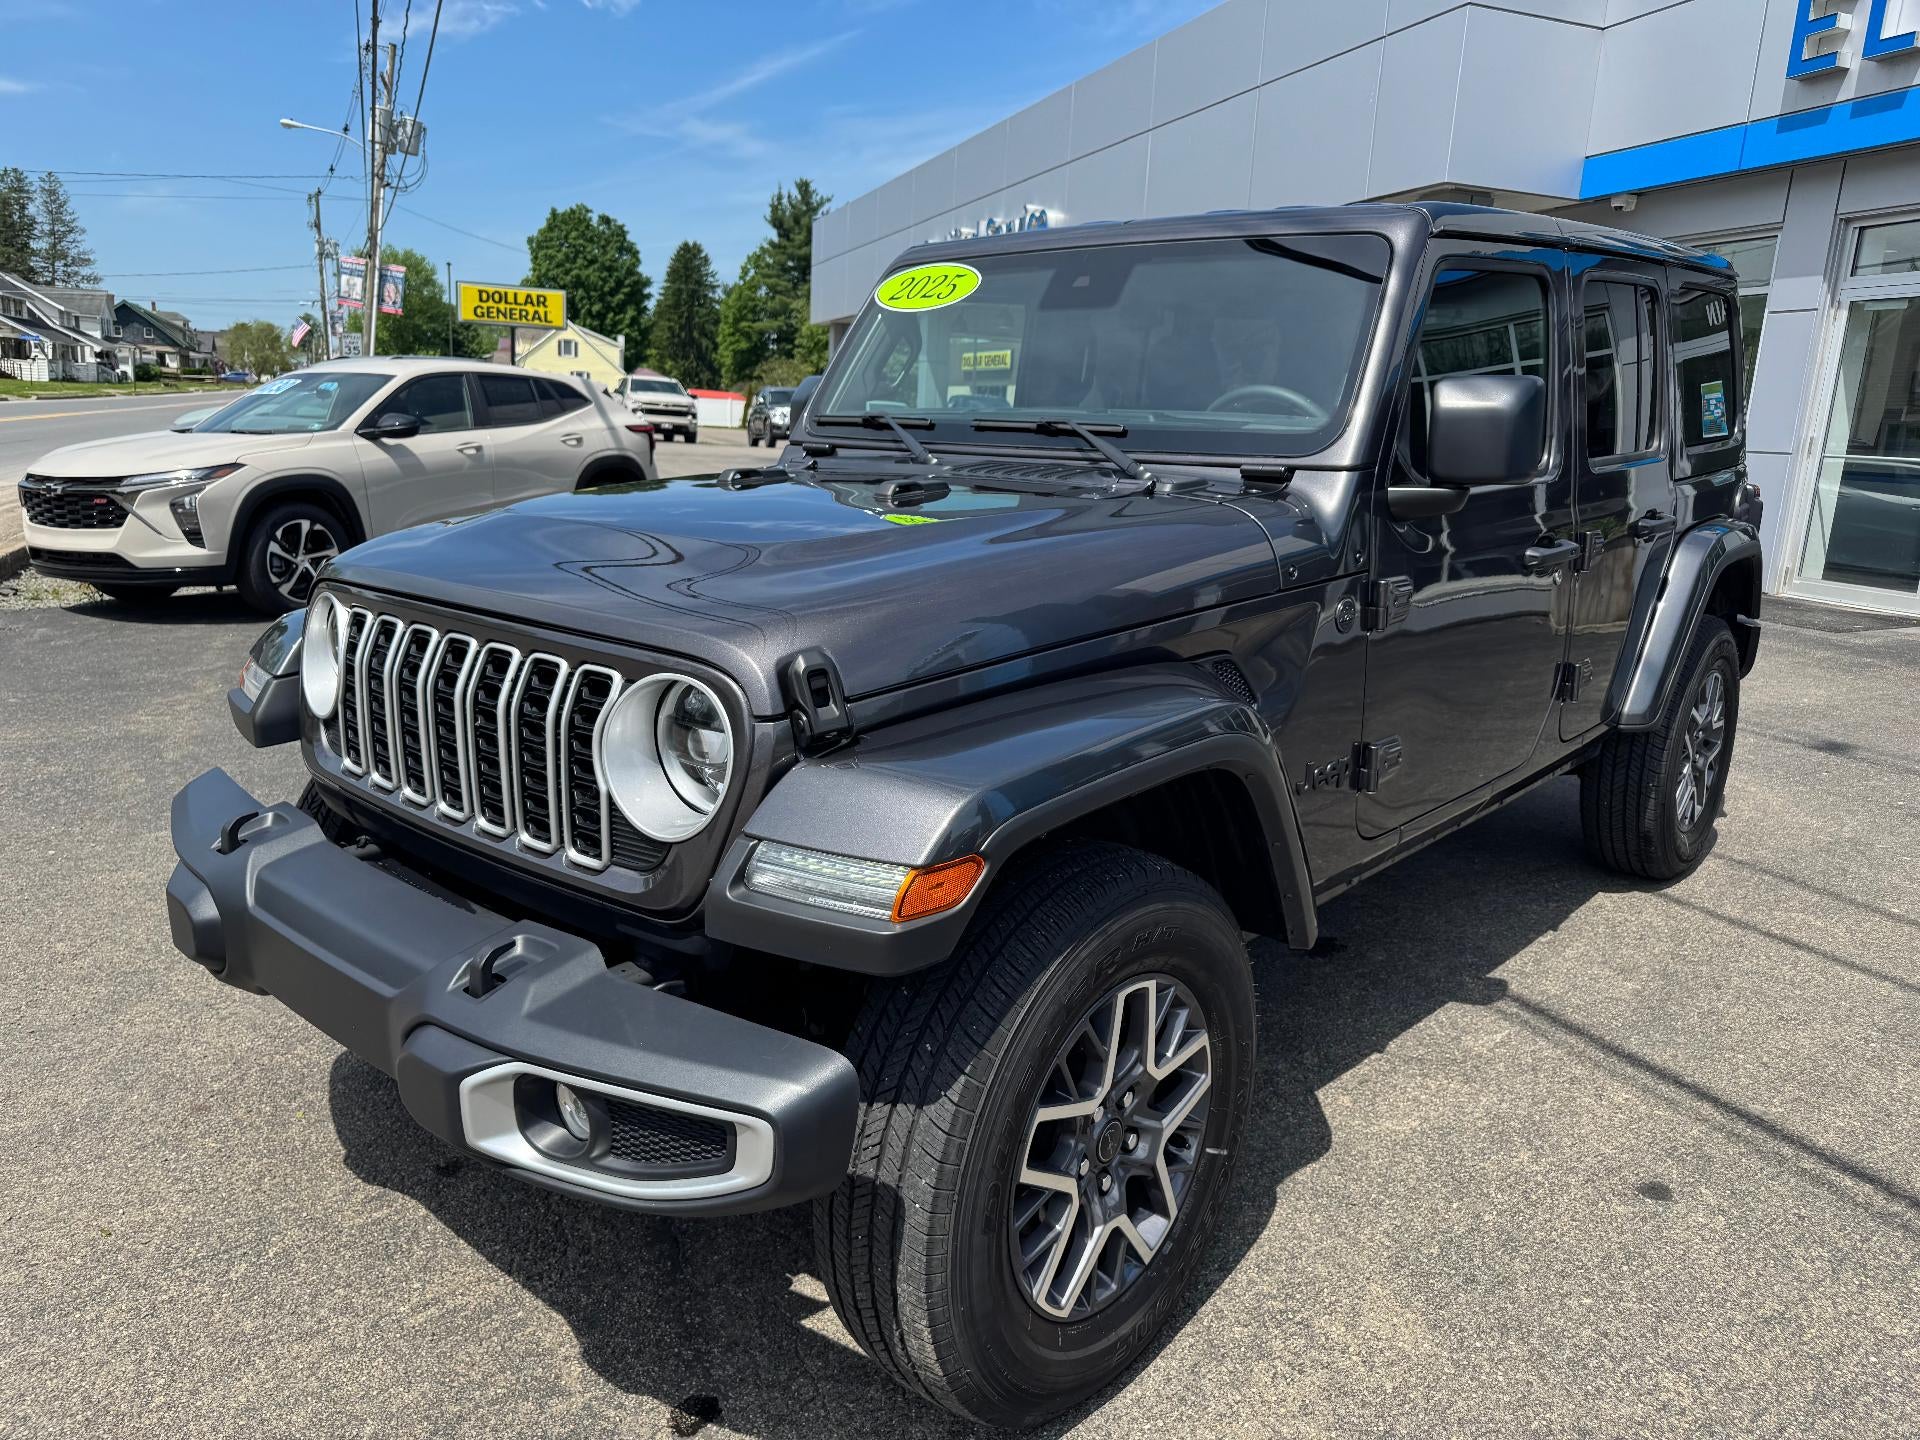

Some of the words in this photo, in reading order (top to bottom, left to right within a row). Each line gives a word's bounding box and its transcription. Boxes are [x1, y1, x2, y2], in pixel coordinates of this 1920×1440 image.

[888, 274, 967, 301] 2025
[478, 289, 548, 308] DOLLAR
[473, 305, 552, 323] GENERAL
[344, 346, 361, 355] 35
[1295, 756, 1350, 796] Jeep
